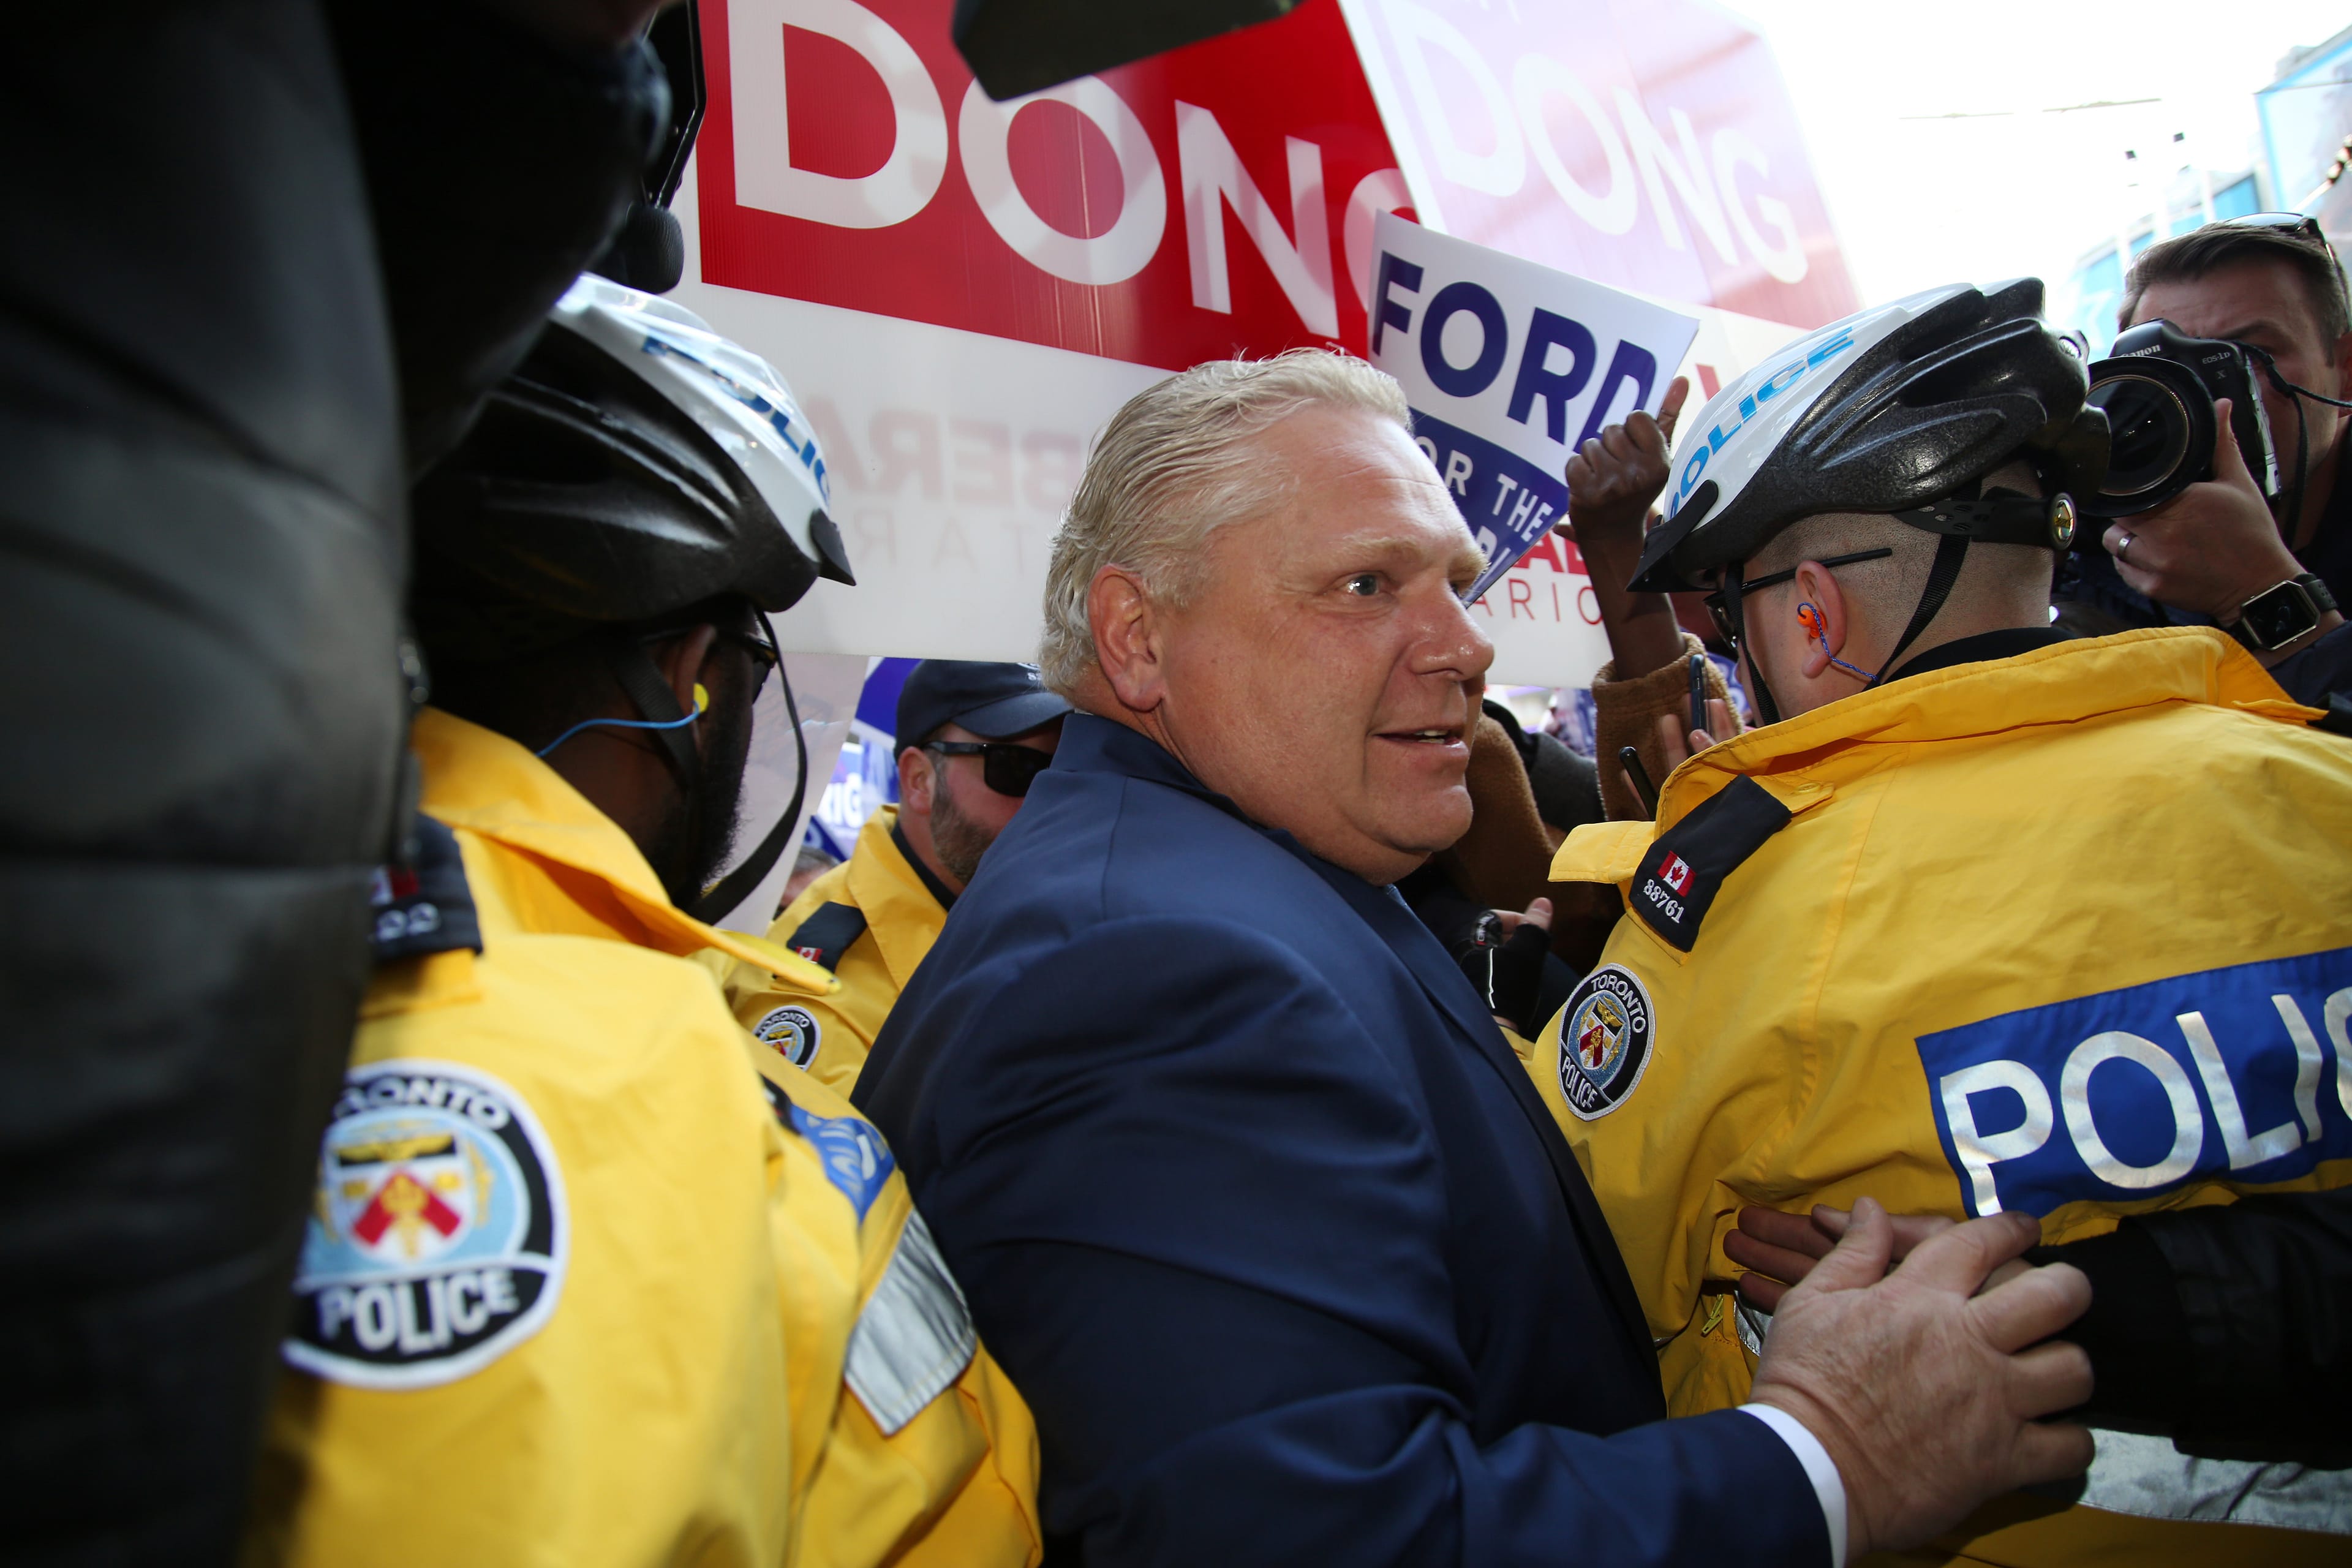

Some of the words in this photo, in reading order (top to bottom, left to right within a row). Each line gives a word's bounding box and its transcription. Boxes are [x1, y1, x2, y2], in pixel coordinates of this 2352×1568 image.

[1376, 0, 1809, 284] DONG
[1372, 250, 1658, 454] FORD
[2202, 352, 2231, 364] EOS-1D
[1492, 473, 1553, 542] THE
[1643, 878, 1685, 924] 88761
[1591, 974, 1646, 1033] TORONTO
[1562, 1055, 1598, 1109] POLICE
[317, 1269, 519, 1354] POLICE
